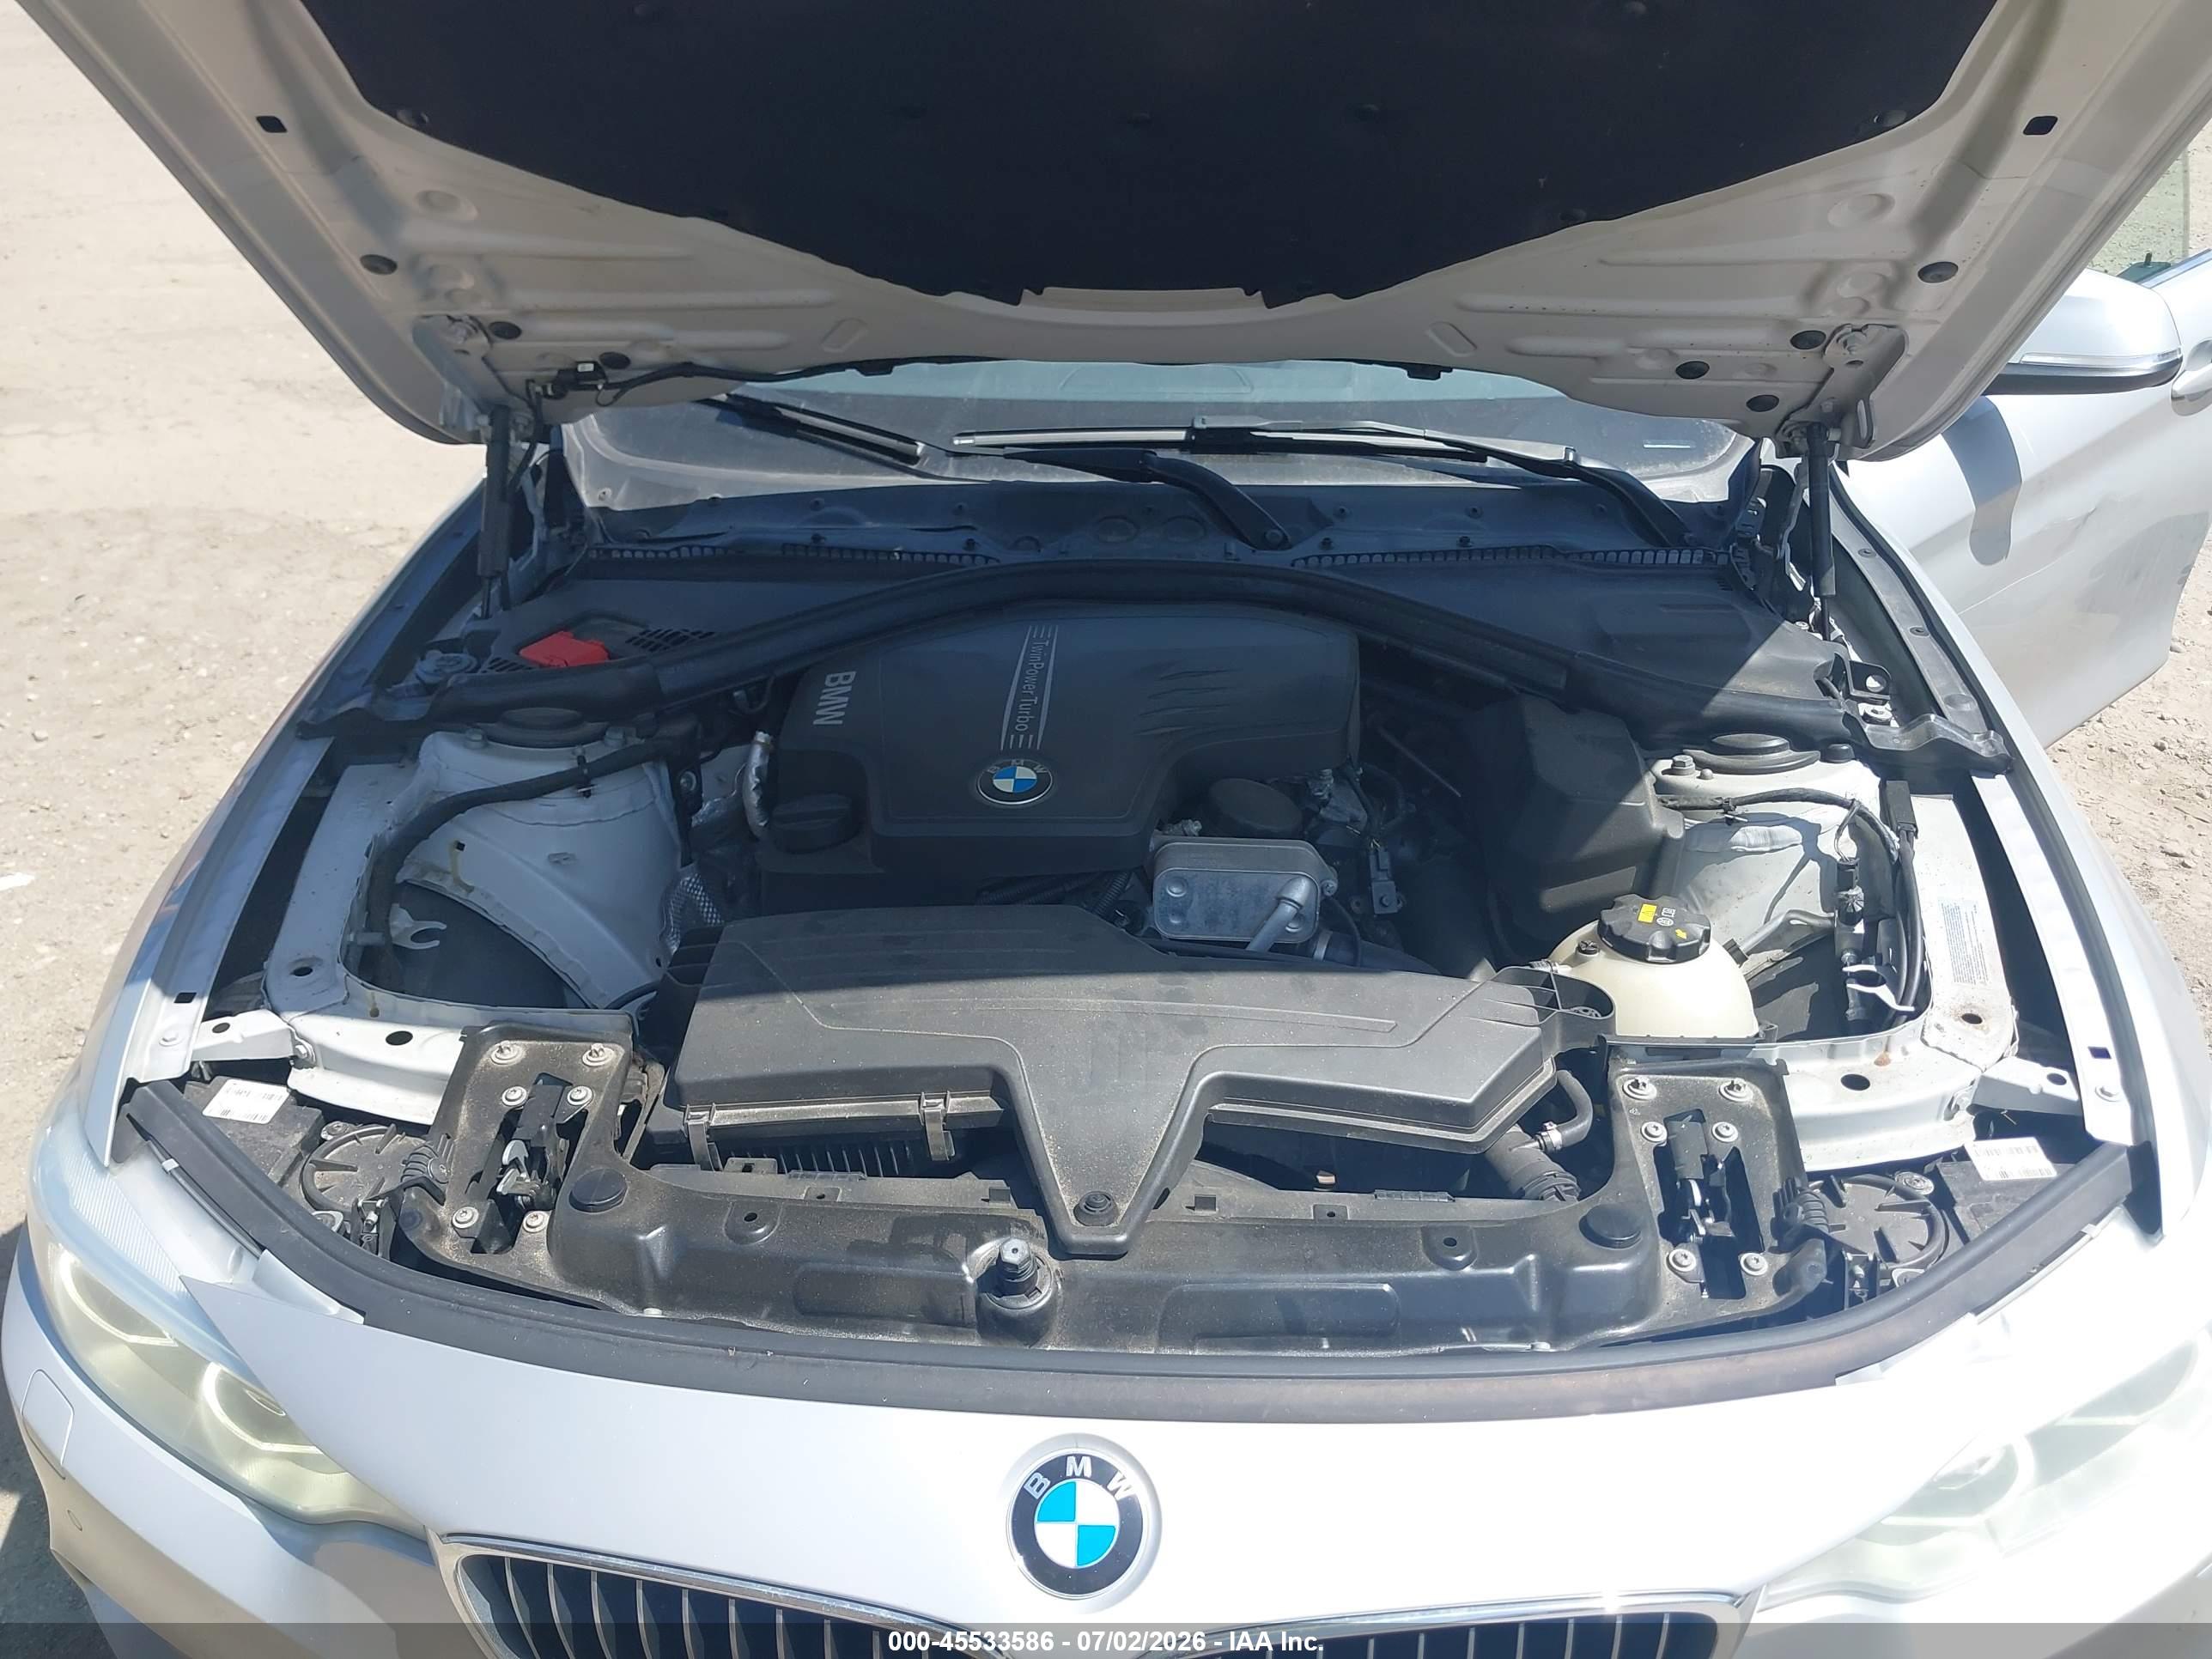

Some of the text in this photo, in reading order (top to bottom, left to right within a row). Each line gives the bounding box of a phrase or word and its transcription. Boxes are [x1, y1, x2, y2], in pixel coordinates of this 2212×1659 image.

[813, 671, 856, 726] BMW
[987, 759, 1048, 774] BMW
[1023, 1455, 1137, 1501] BMW
